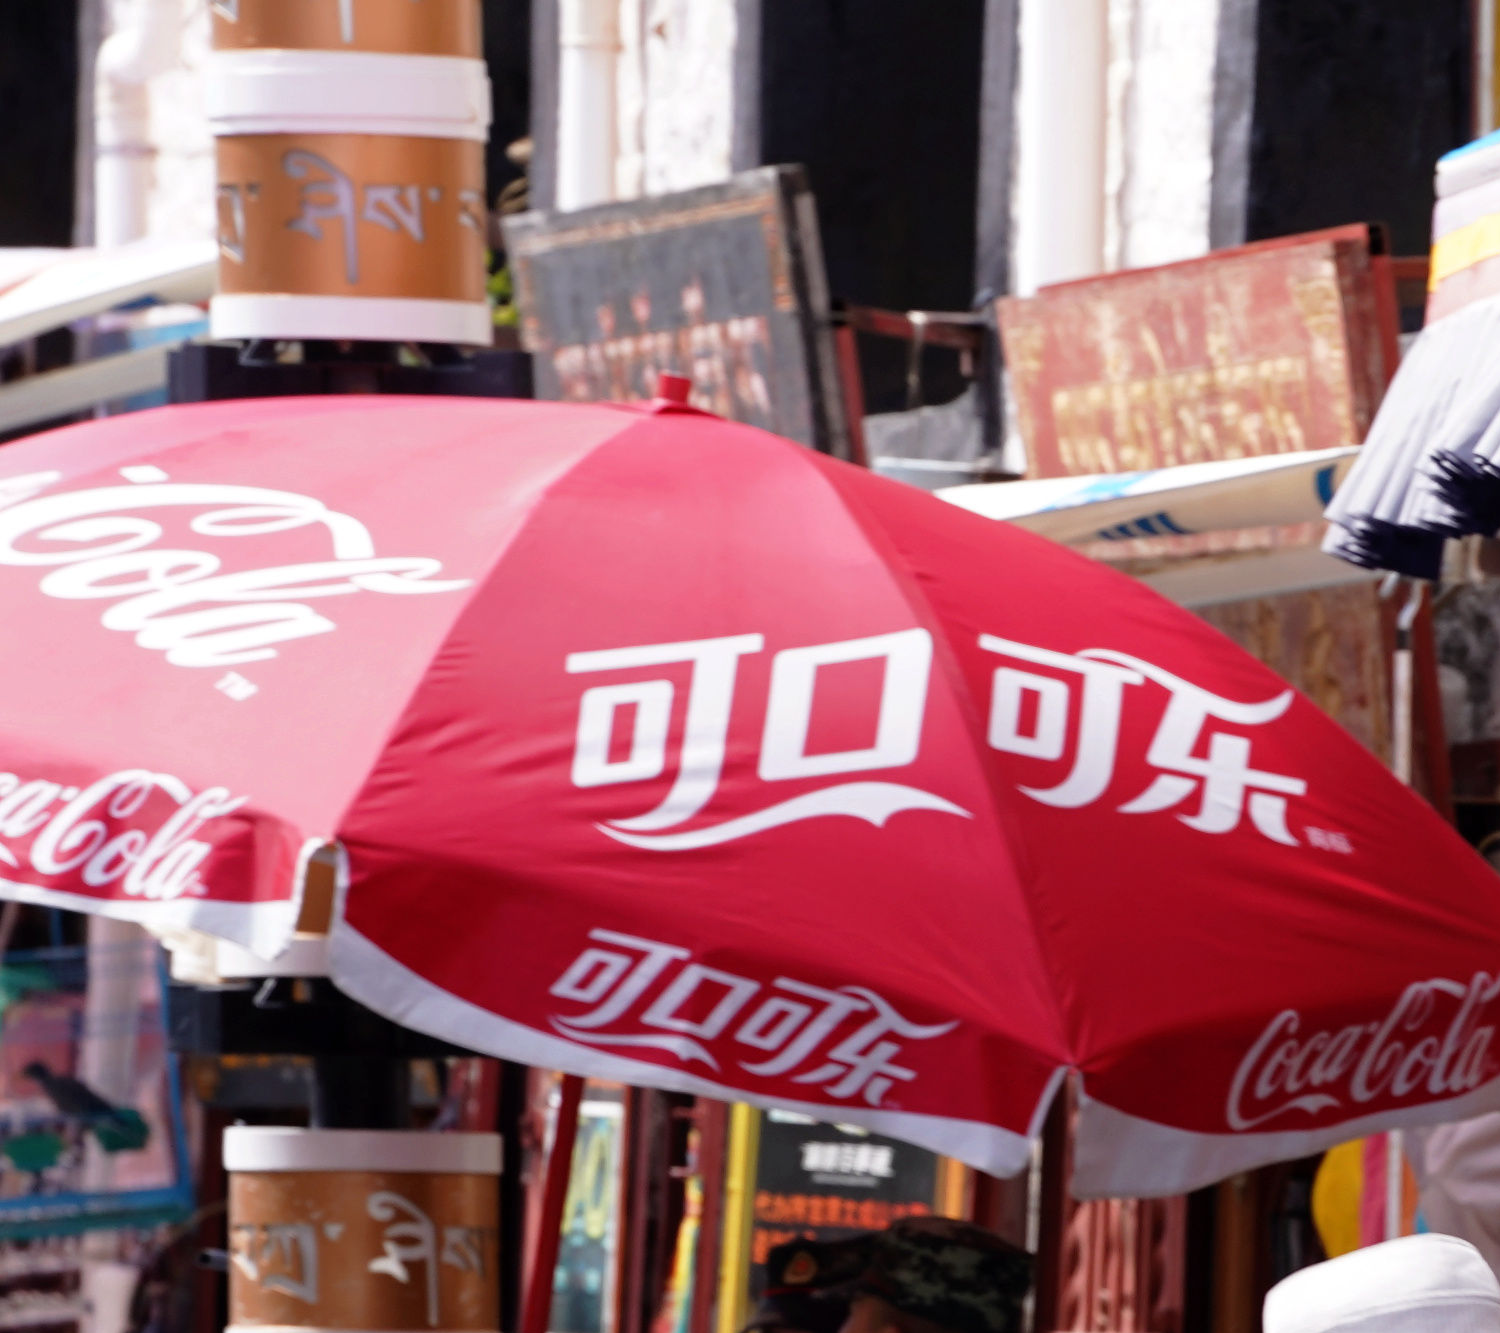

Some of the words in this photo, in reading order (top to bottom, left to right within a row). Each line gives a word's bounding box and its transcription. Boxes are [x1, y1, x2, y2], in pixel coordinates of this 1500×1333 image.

[565, 627, 1309, 852] 可口可乐
[547, 926, 962, 1107] 可口可乐
